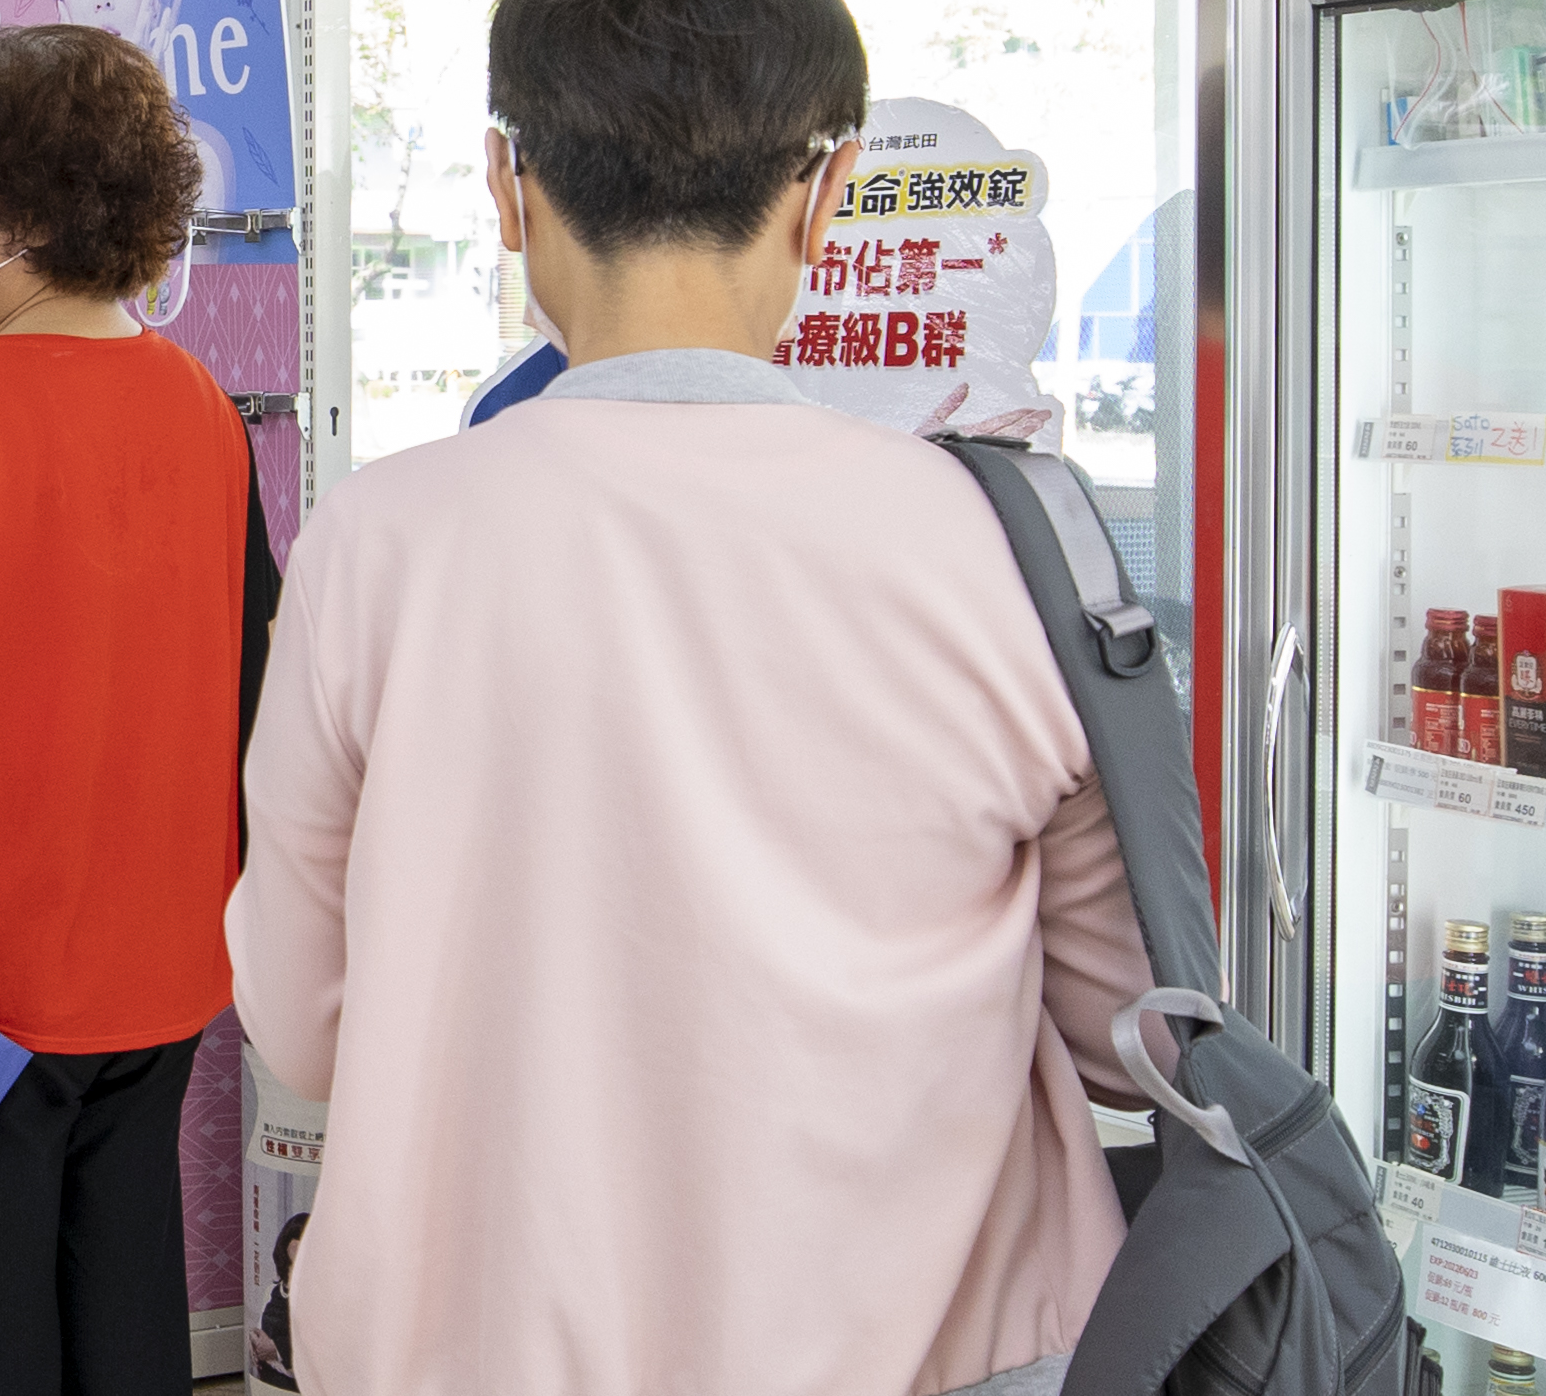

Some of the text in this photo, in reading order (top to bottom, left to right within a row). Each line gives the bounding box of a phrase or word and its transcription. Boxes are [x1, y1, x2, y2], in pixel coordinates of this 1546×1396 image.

[868, 133, 938, 152] 台灣武田
[1515, 804, 1535, 816] 450
